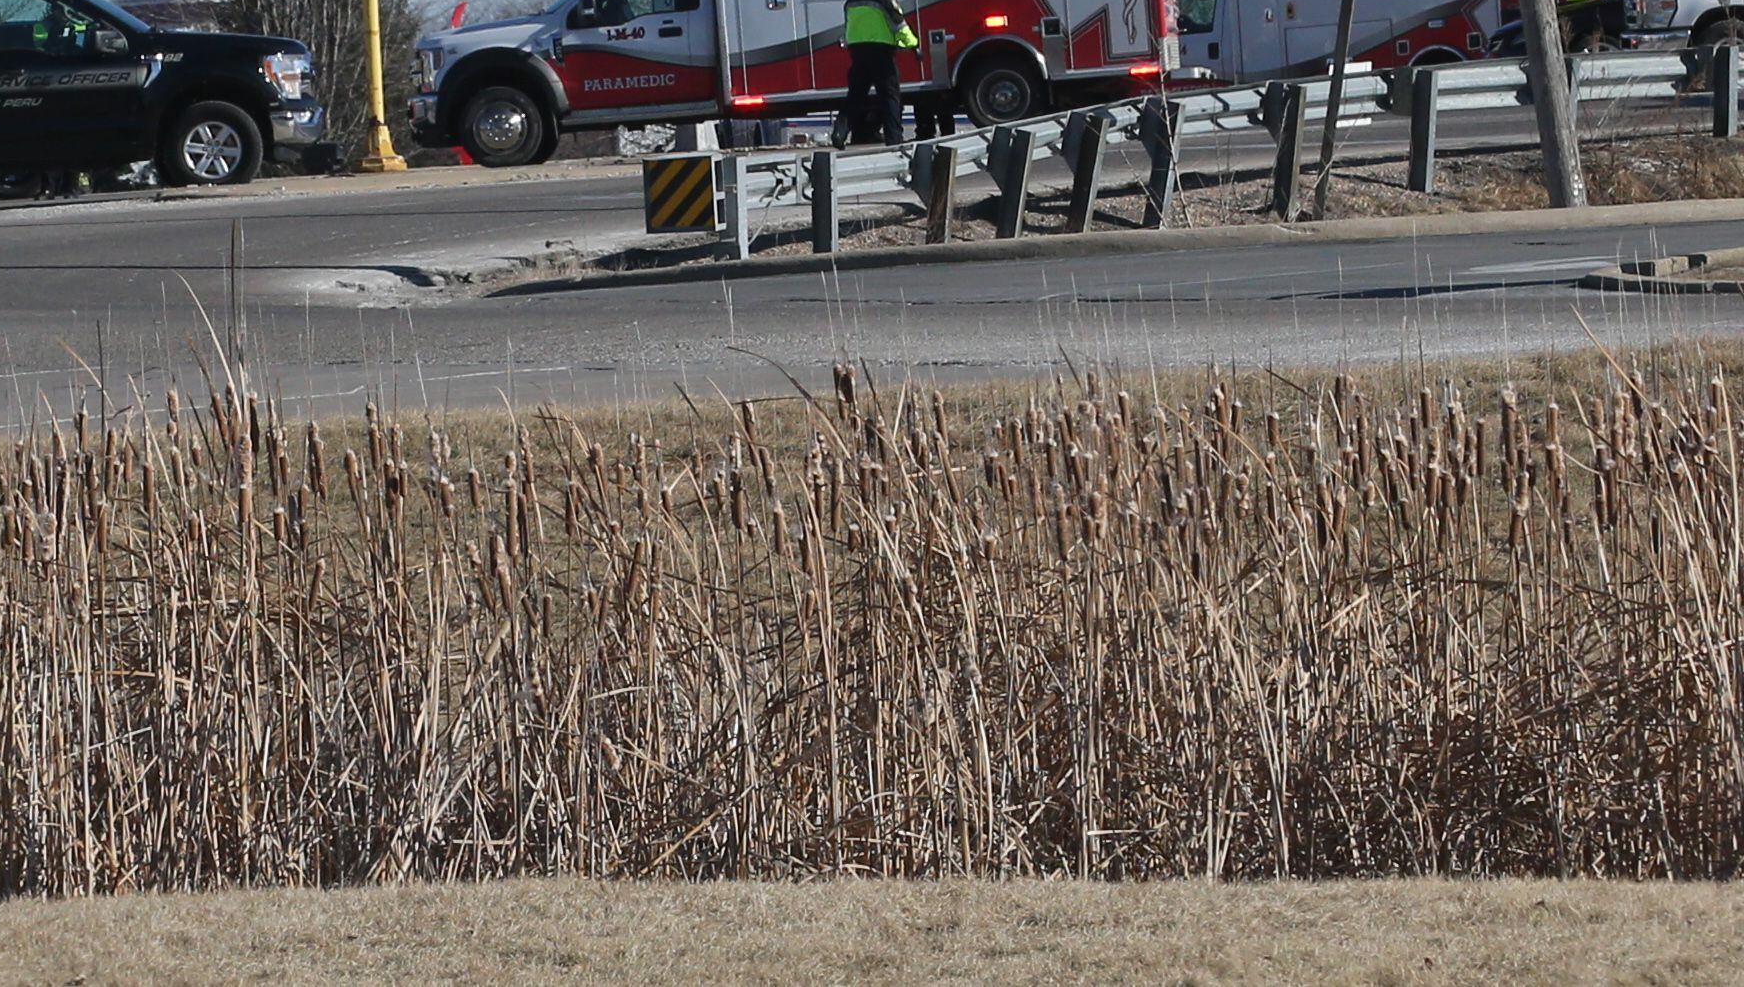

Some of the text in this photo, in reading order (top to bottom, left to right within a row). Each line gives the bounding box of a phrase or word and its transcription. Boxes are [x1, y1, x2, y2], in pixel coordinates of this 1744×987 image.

[57, 71, 132, 86] OFFICER
[584, 74, 676, 92] PARAMEDIC
[3, 98, 43, 108] PERU
